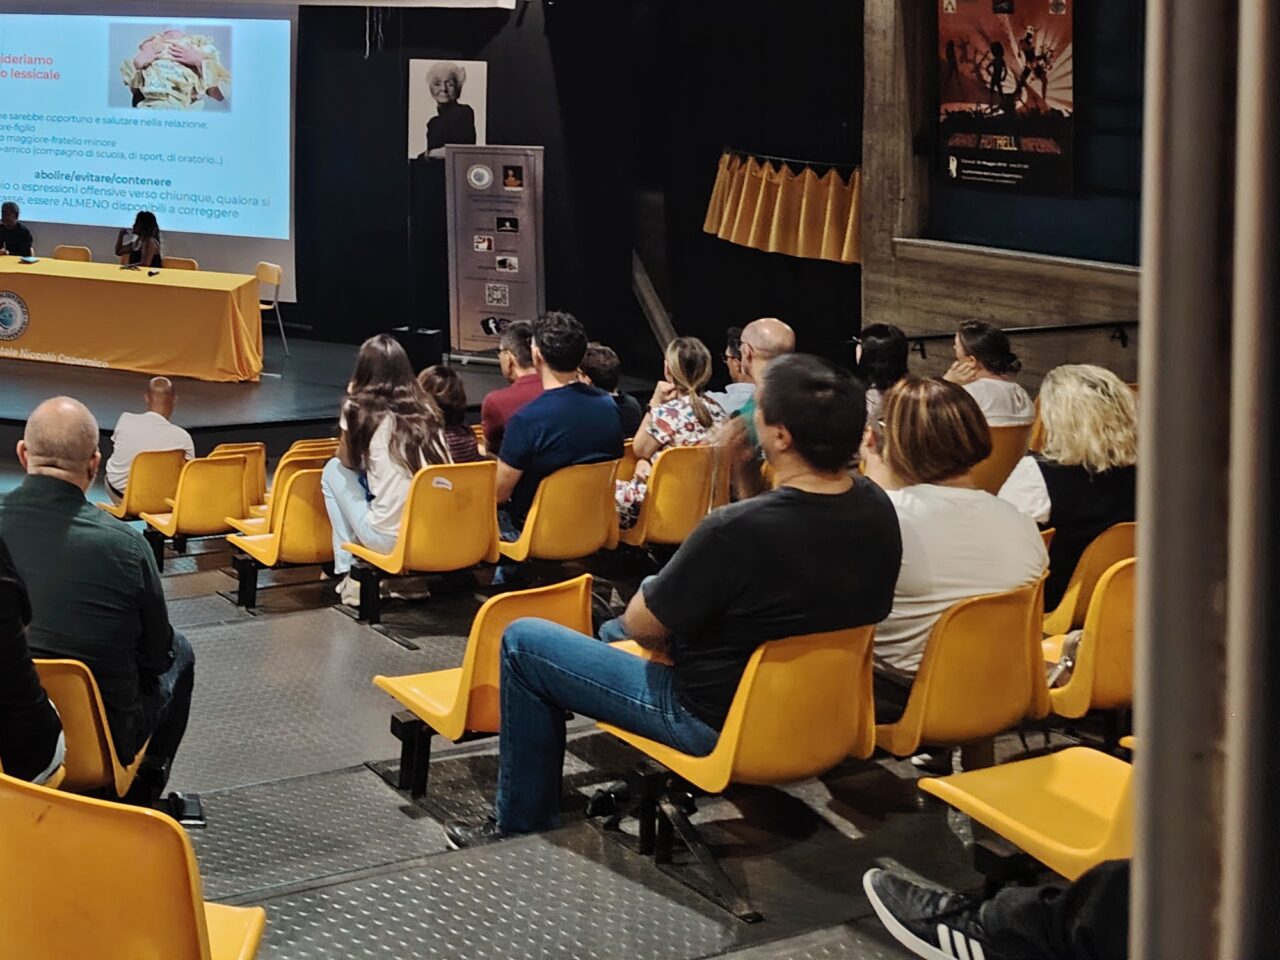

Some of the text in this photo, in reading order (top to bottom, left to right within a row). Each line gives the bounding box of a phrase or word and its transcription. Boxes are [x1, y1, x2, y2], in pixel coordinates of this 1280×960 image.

[10, 68, 61, 80] lessicale
[9, 111, 44, 121] sarebbe
[46, 114, 93, 125] opportuno
[102, 116, 138, 126] salutare
[140, 117, 162, 127] nella
[6, 135, 82, 146] maggiore-fratello
[83, 138, 116, 147] minore
[34, 170, 172, 187] abolire/evitare/contenere
[22, 182, 79, 194] espressioni
[80, 185, 126, 197] offensive
[128, 189, 157, 199] verso
[216, 194, 259, 207] qualora
[28, 196, 60, 206] essere
[62, 196, 109, 210] ALMENO
[177, 207, 239, 219] correggere
